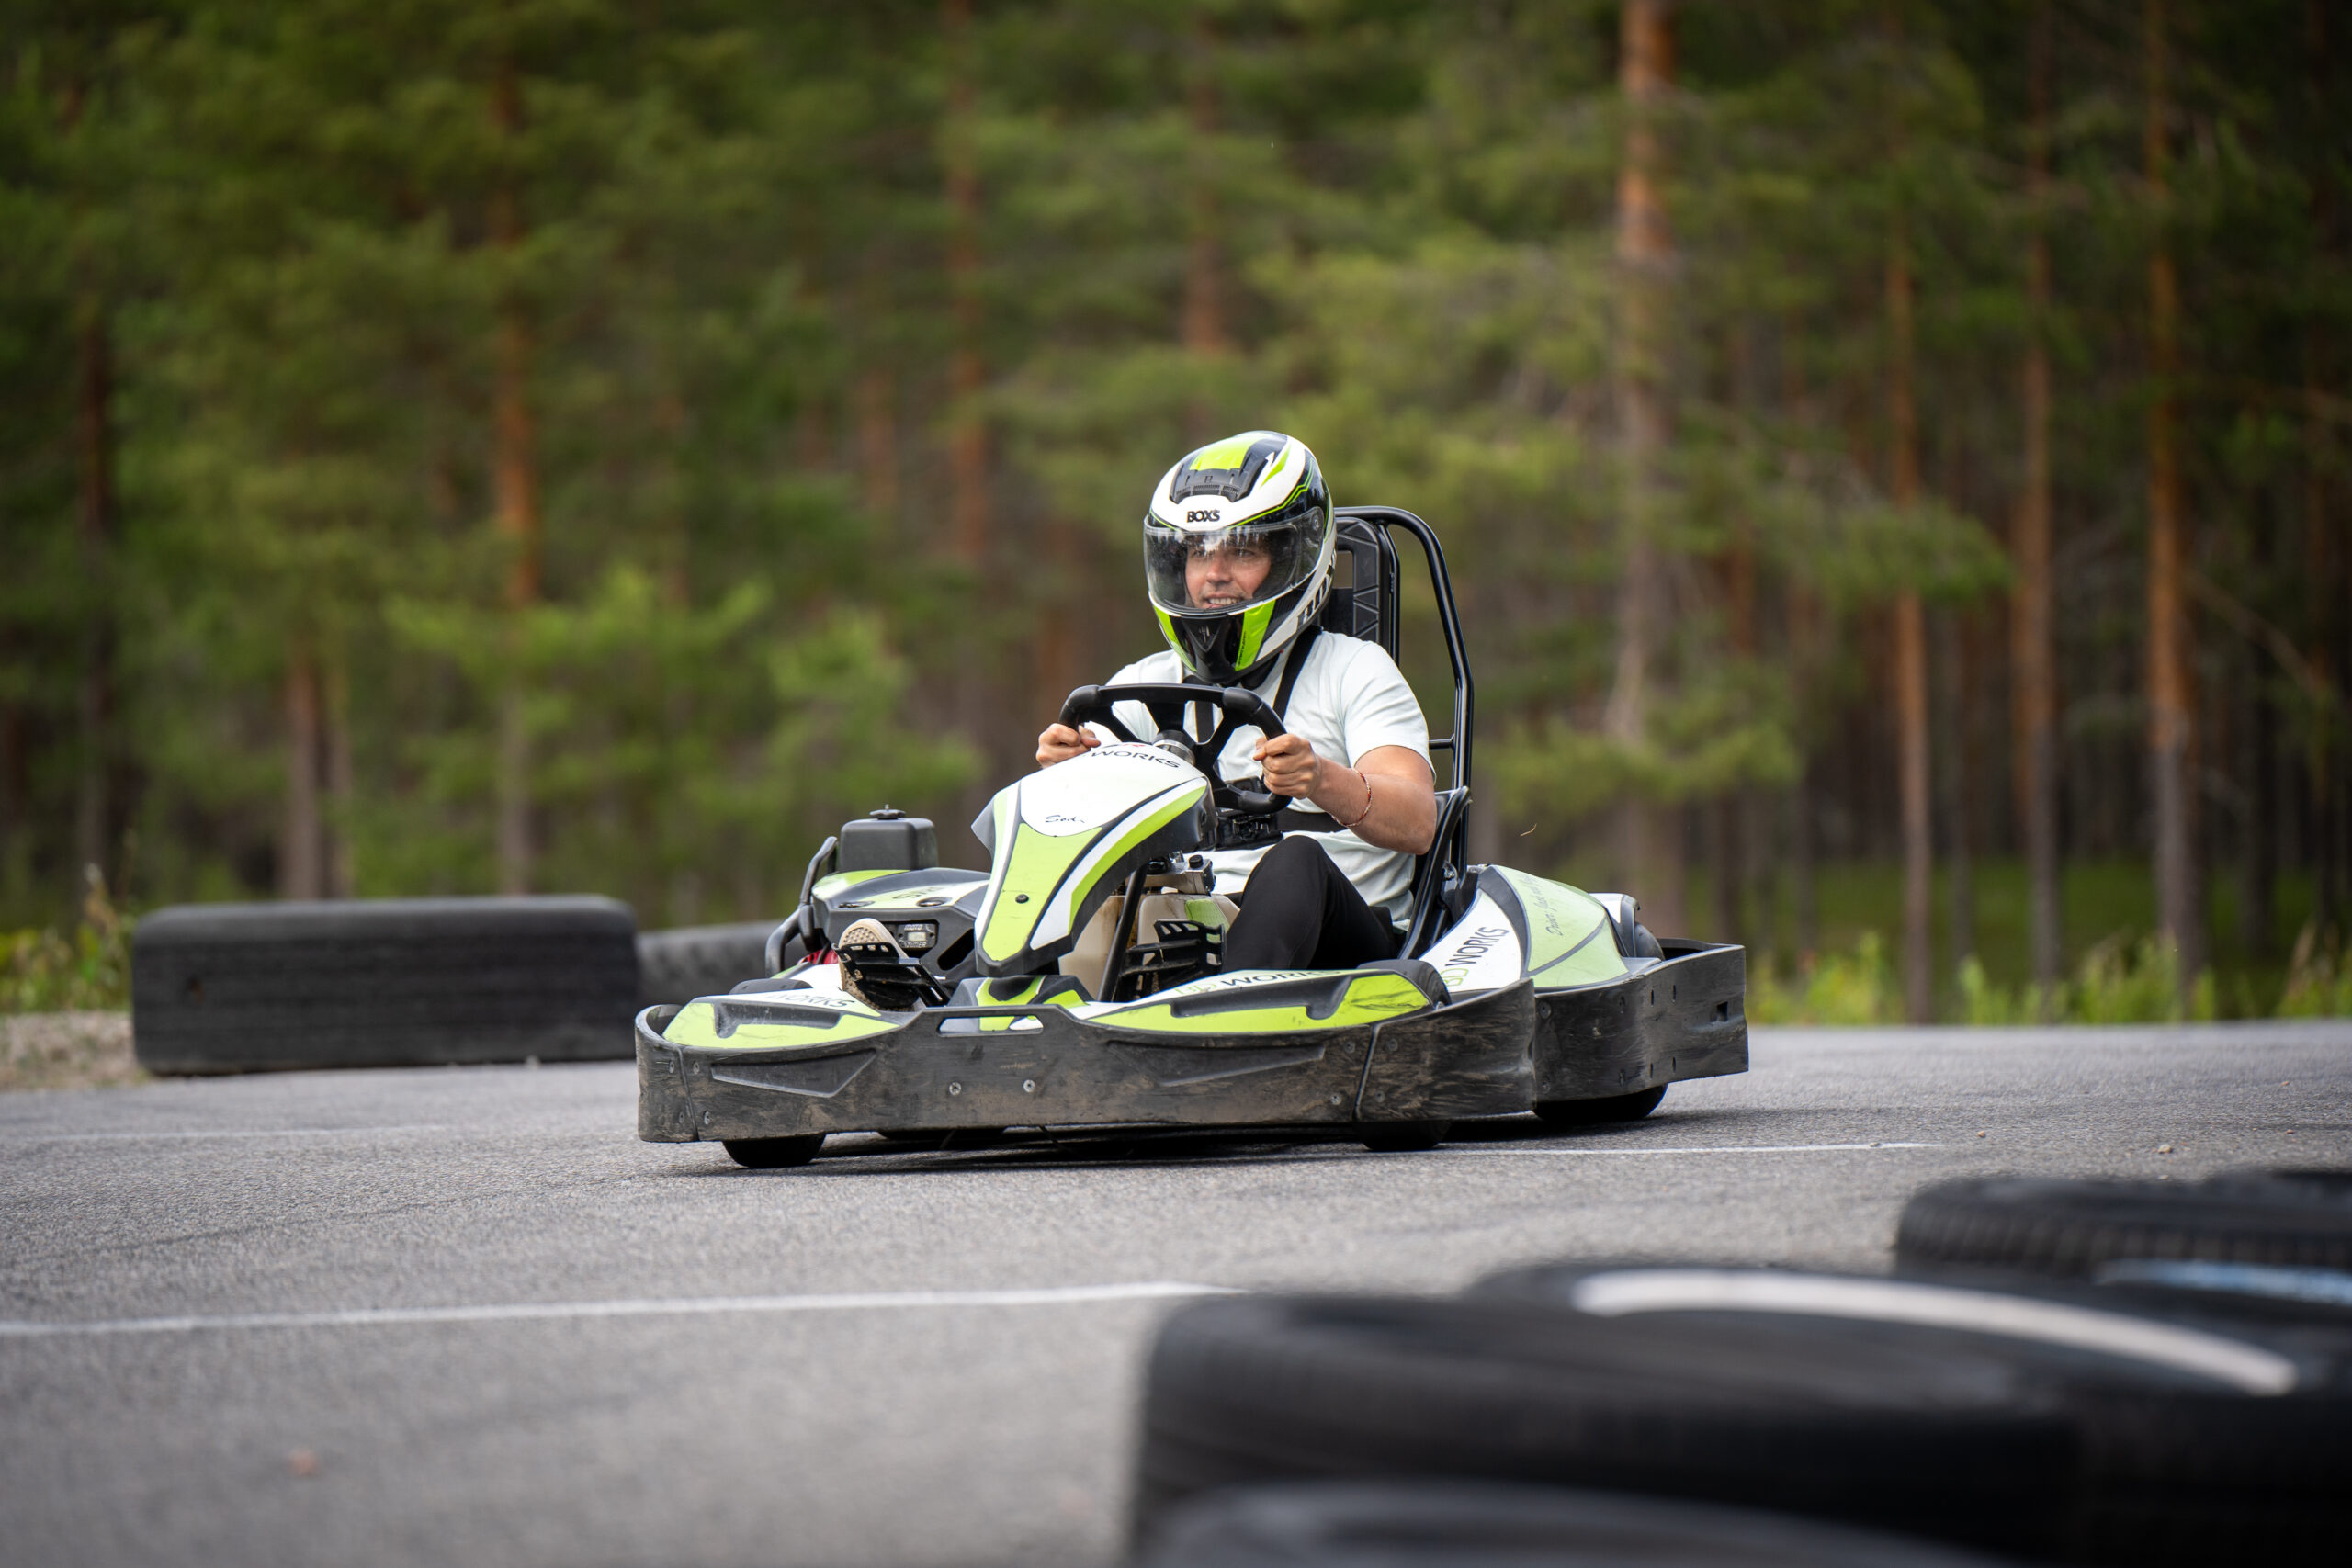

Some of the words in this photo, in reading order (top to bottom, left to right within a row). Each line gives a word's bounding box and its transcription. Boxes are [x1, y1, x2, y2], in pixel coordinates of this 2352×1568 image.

[1186, 509, 1221, 523] BOXS
[1091, 750, 1181, 768] WORKS
[1444, 926, 1510, 967] WORKS
